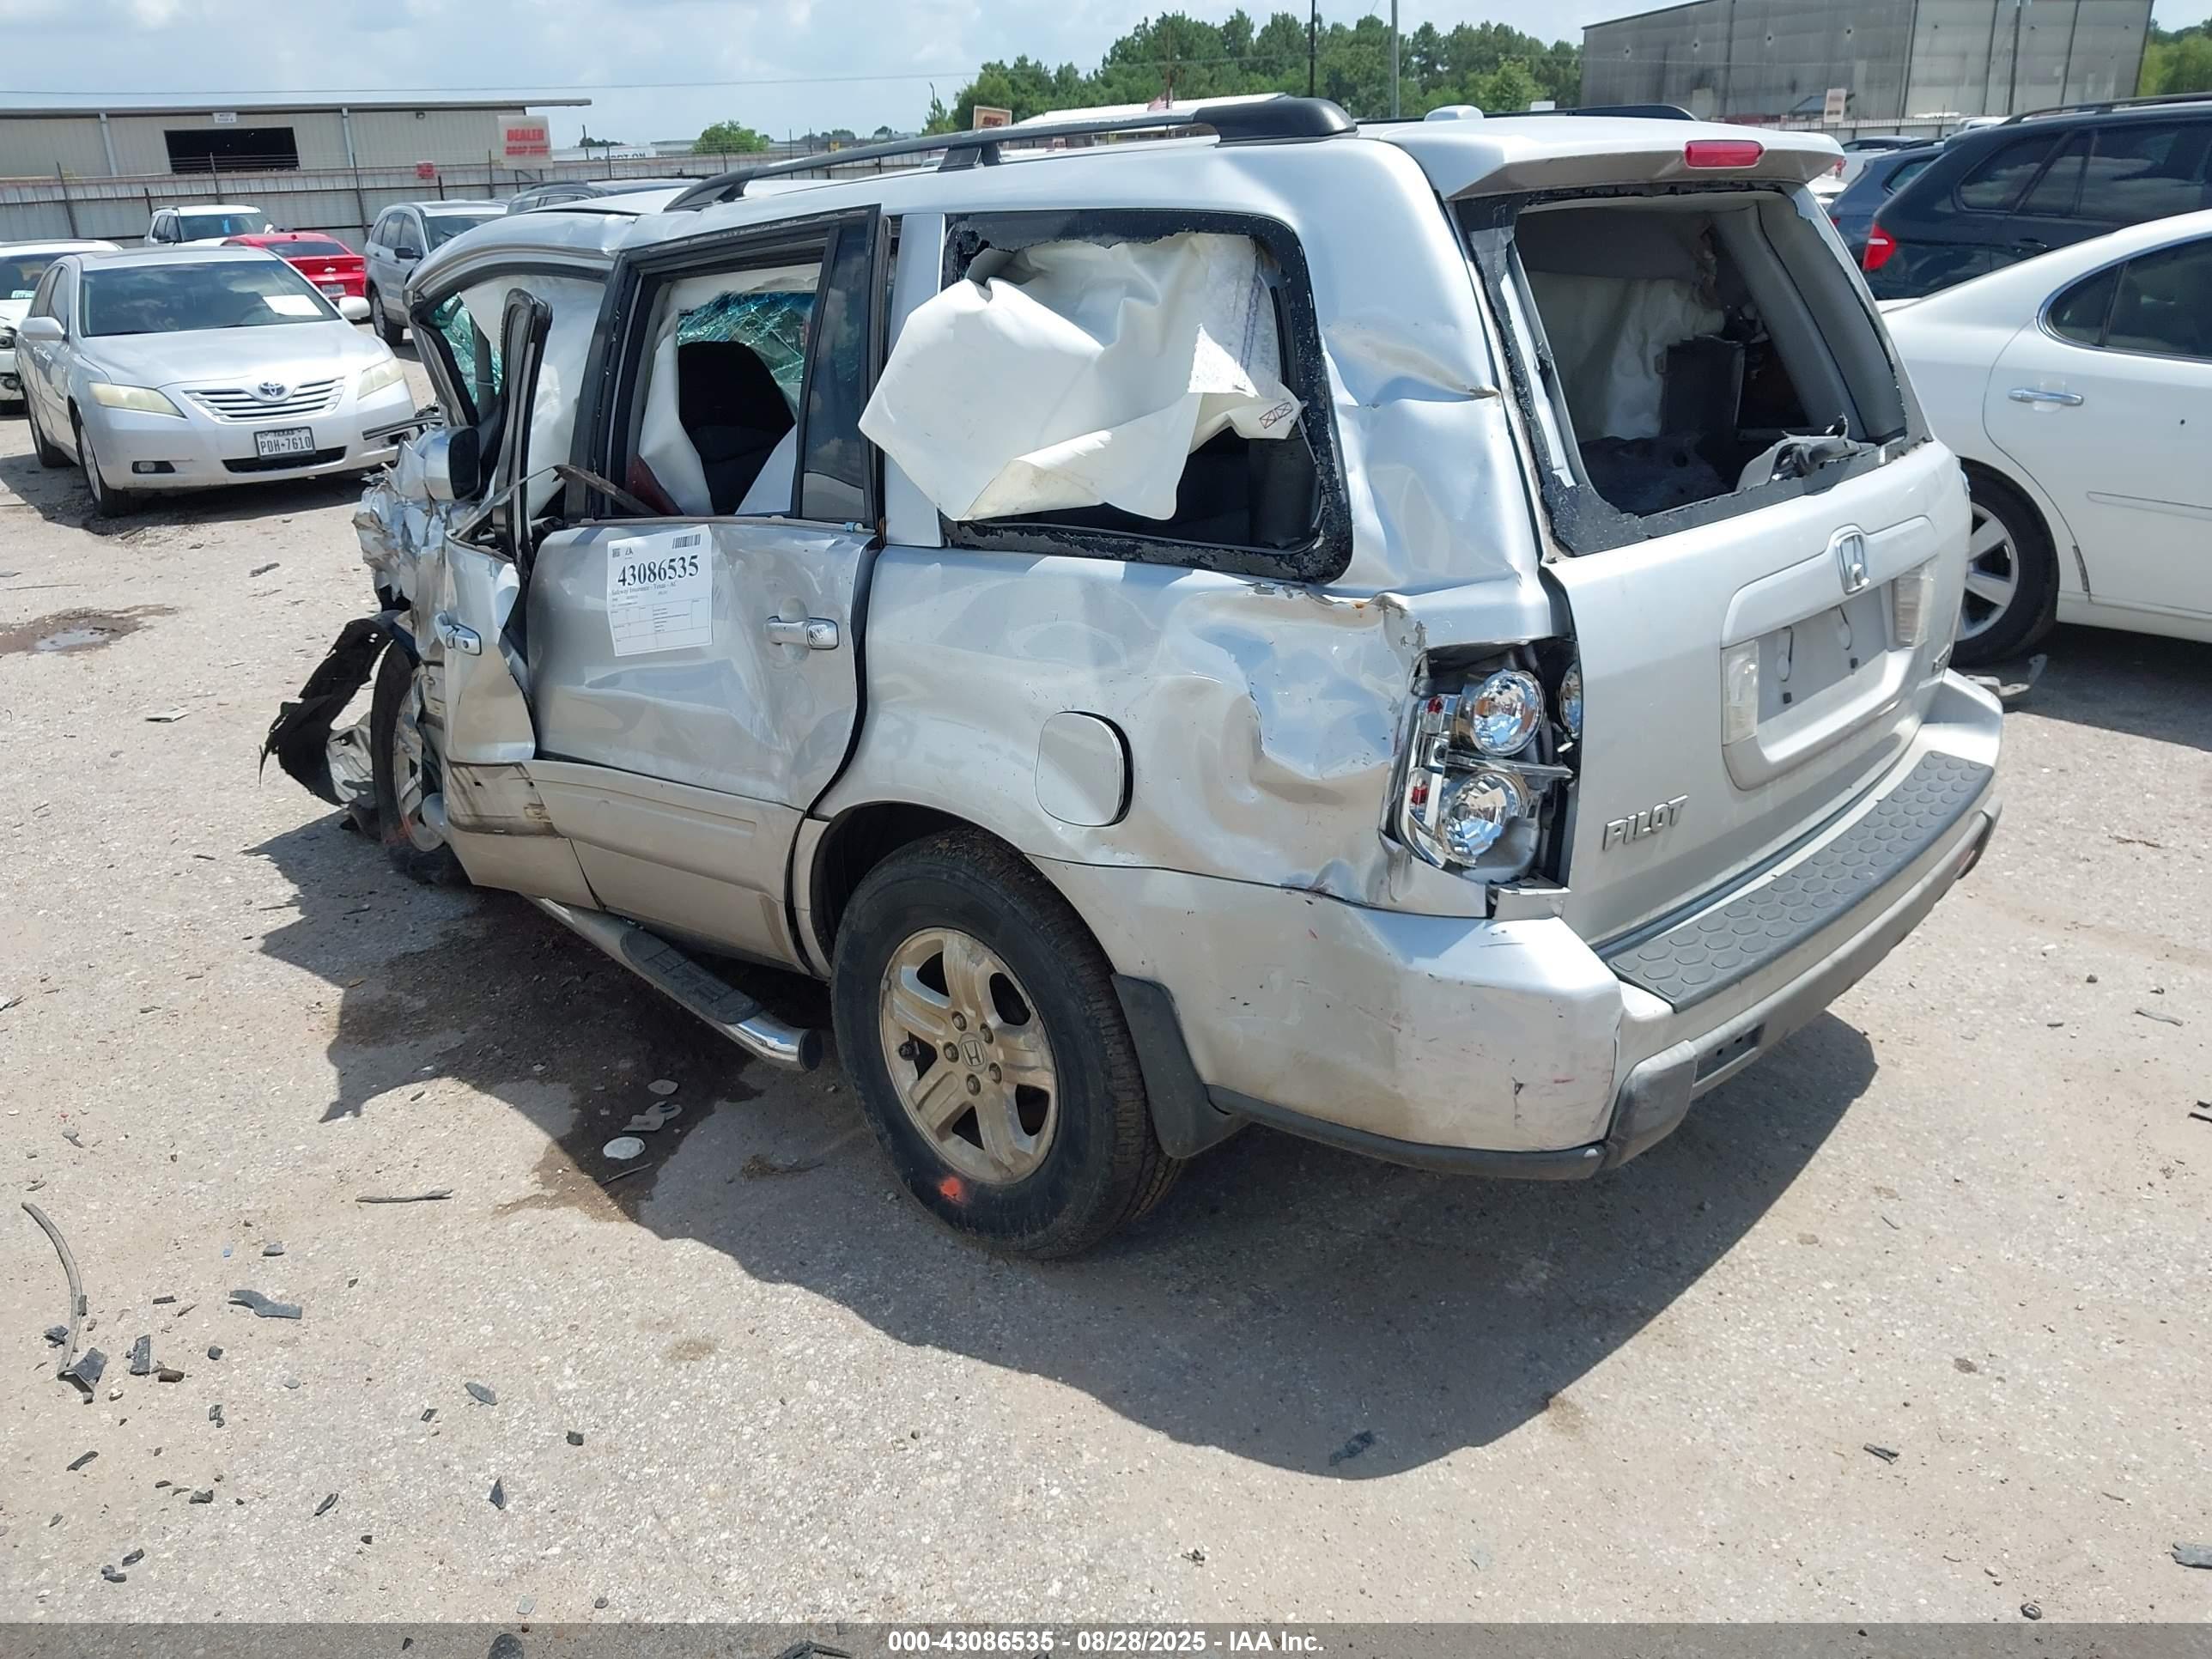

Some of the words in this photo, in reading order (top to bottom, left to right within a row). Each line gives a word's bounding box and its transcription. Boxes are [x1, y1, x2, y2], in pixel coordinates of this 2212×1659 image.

[507, 129, 544, 142] DEALER
[617, 554, 700, 586] 43086535
[1601, 793, 1689, 852] PILOT
